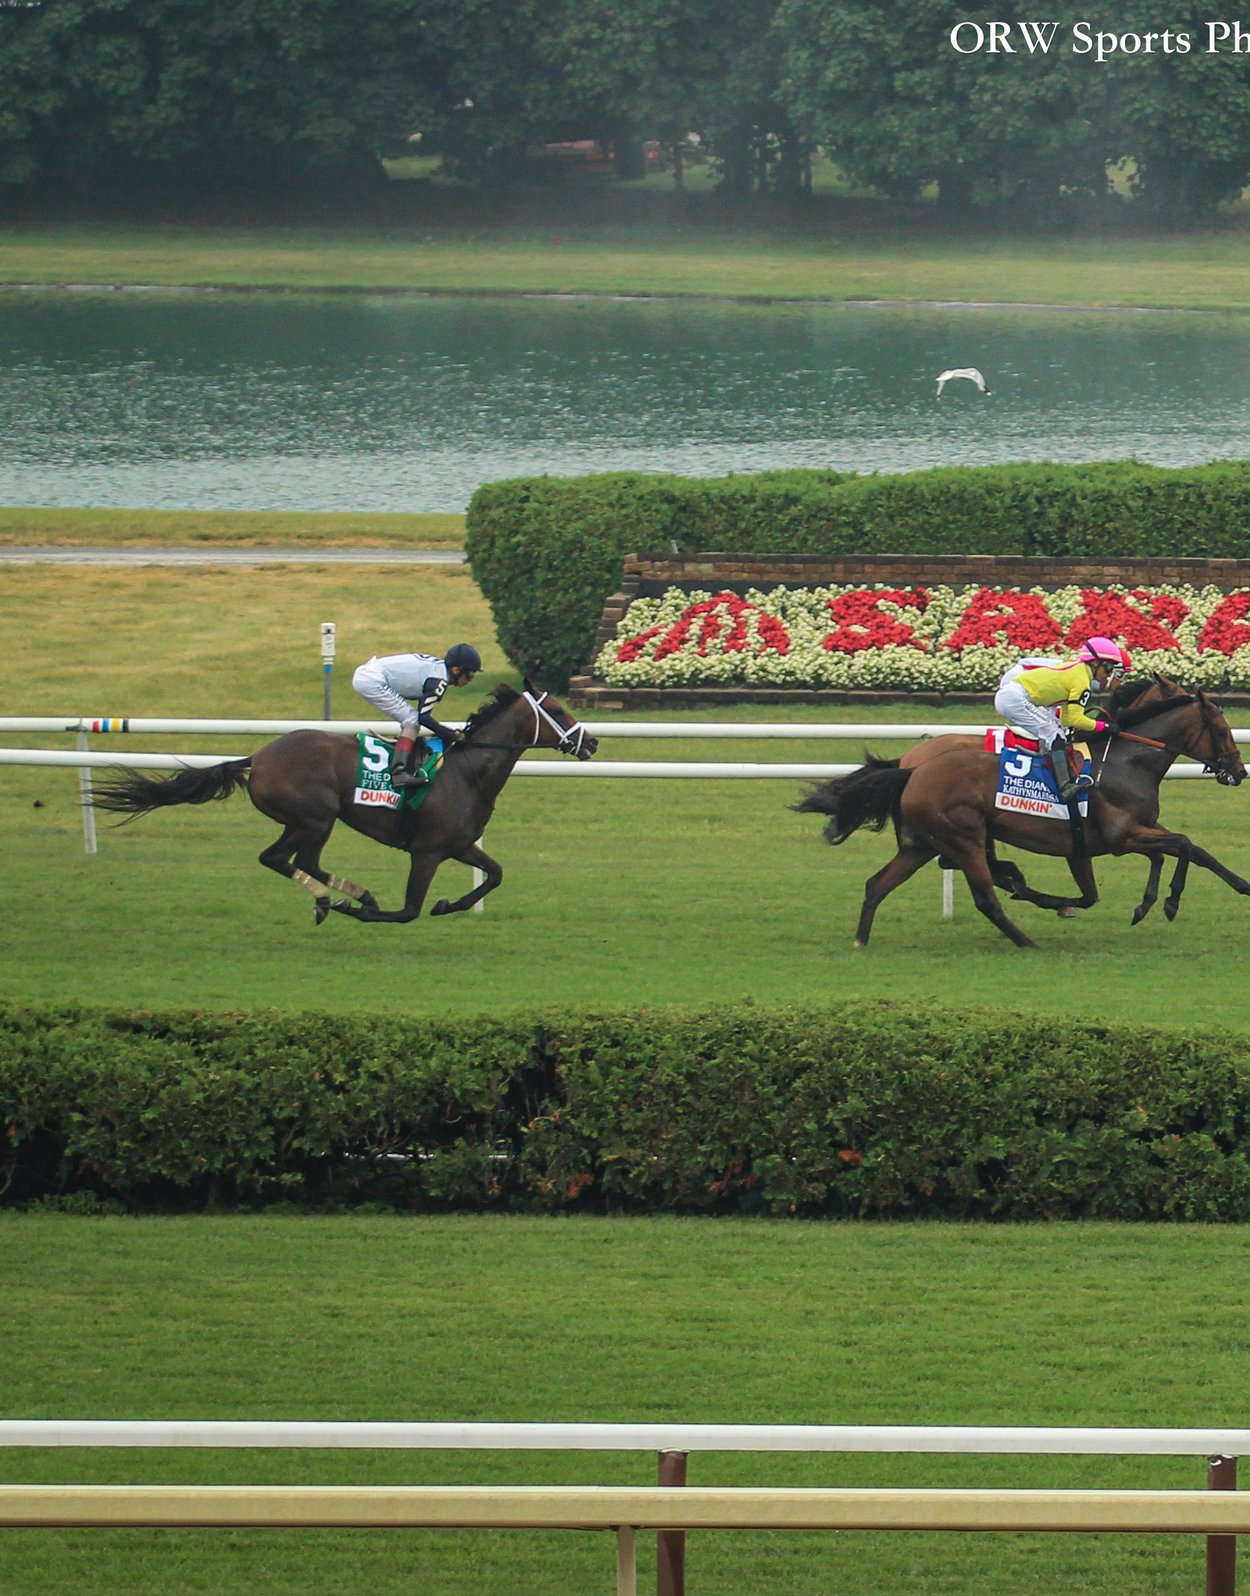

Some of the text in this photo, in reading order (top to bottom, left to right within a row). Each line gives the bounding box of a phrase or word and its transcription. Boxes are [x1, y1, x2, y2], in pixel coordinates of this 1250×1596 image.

[435, 681, 447, 696] 5
[1080, 692, 1090, 706] 3
[362, 735, 390, 772] 5
[362, 770, 383, 781] THE
[1003, 775, 1024, 787] THE
[361, 779, 388, 790] FIVE
[1001, 795, 1053, 814] DUNKIN'
